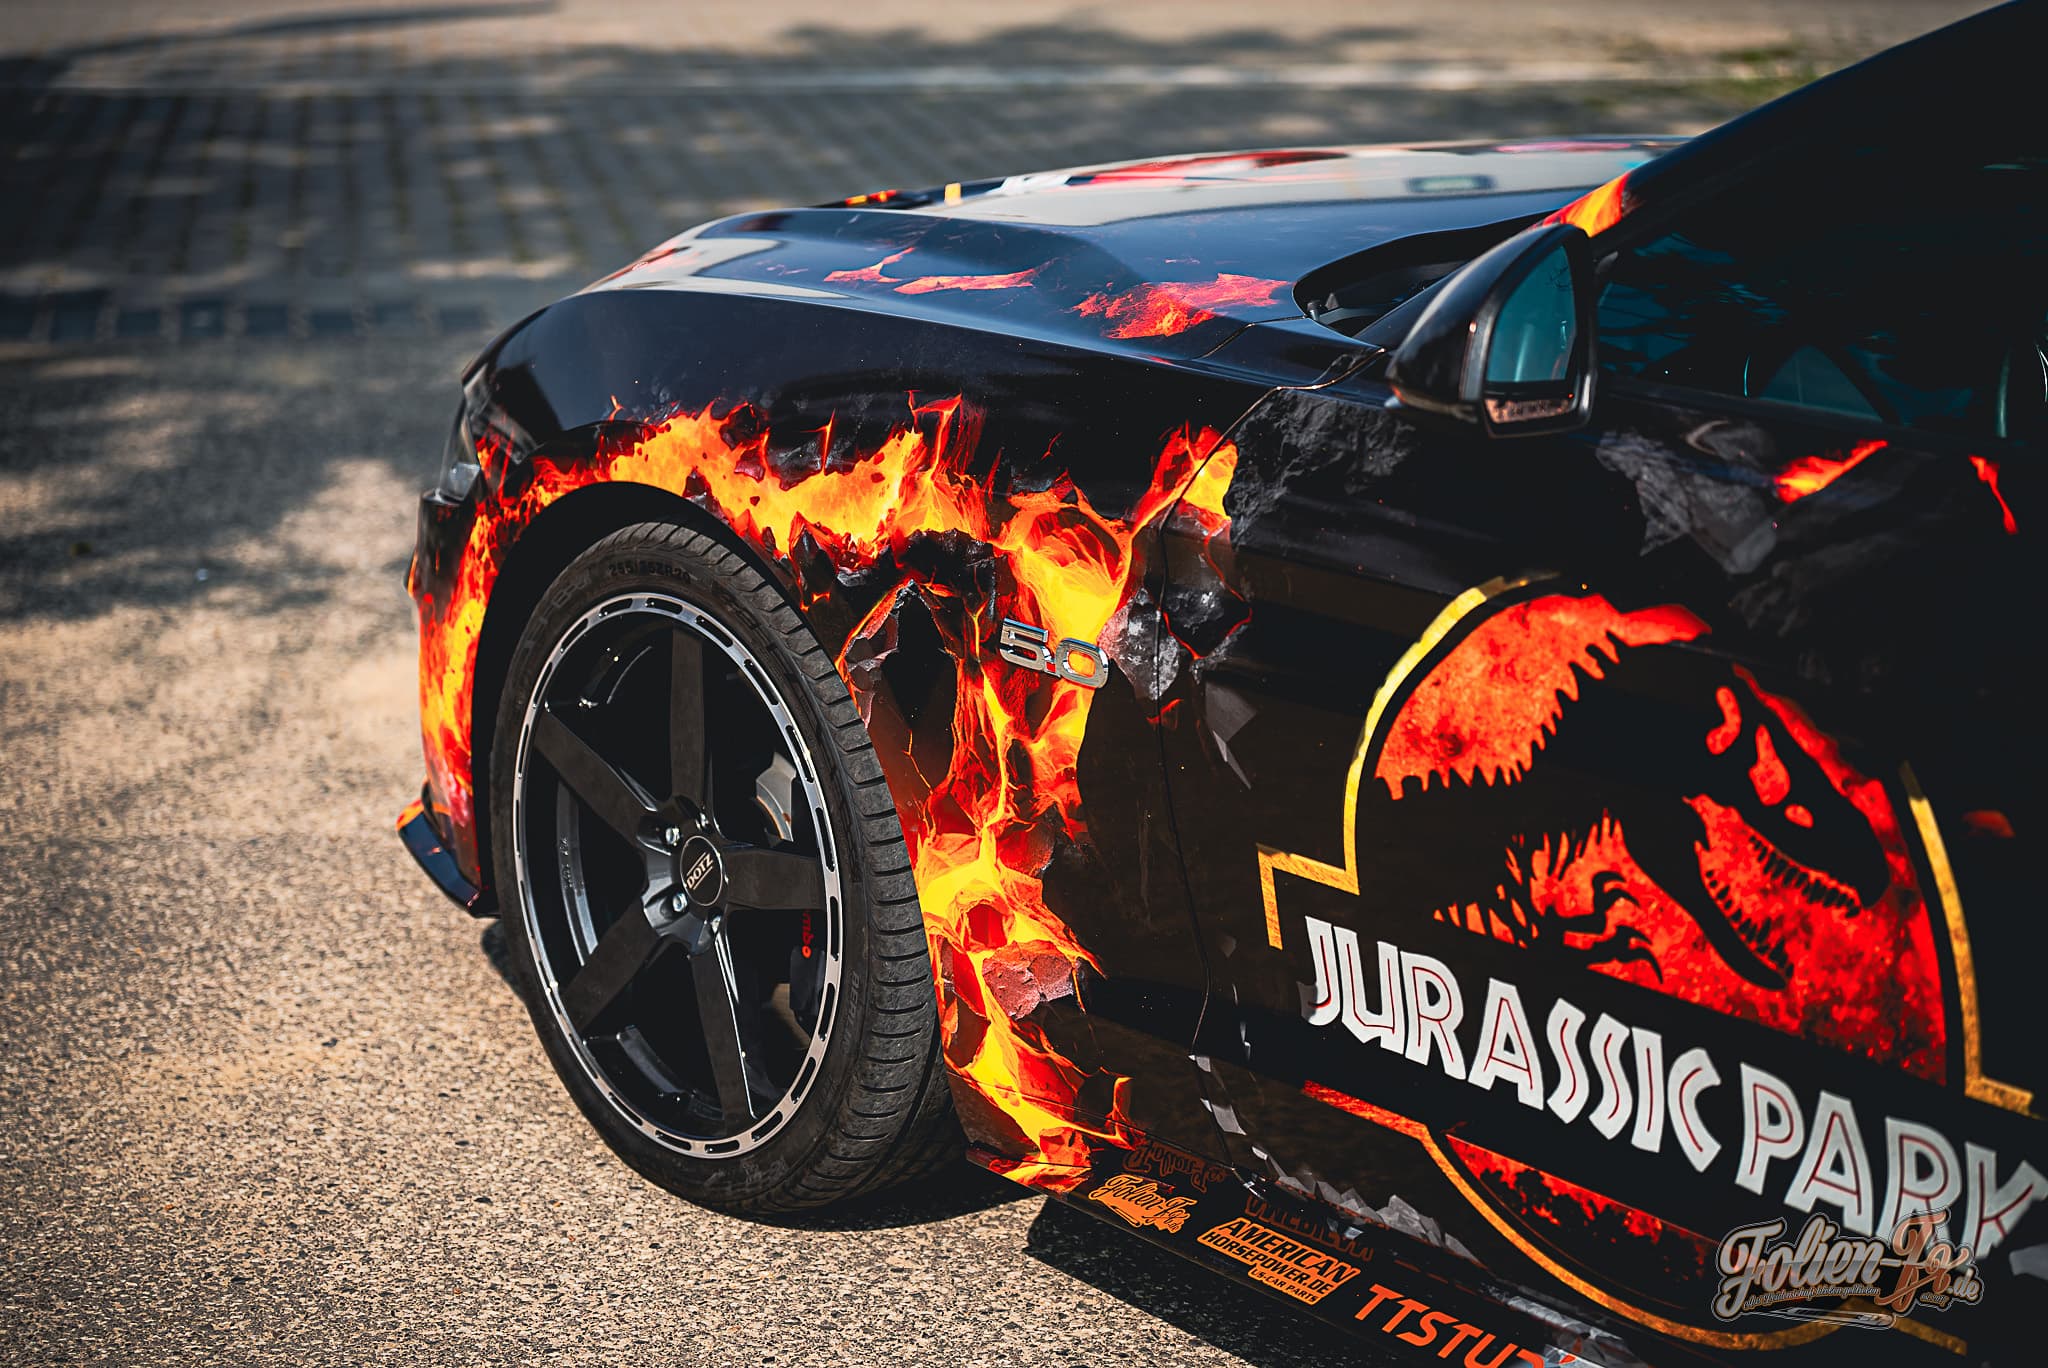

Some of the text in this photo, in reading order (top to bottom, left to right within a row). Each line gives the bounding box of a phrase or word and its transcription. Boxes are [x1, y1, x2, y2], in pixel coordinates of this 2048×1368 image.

[686, 853, 713, 889] DOTZ
[1296, 915, 2048, 1259] JURASSIC PARK
[1202, 1231, 1334, 1295] HORSEPOWER.DE
[1218, 1220, 1356, 1283] AMERICAN
[1285, 1283, 1319, 1302] PARTS
